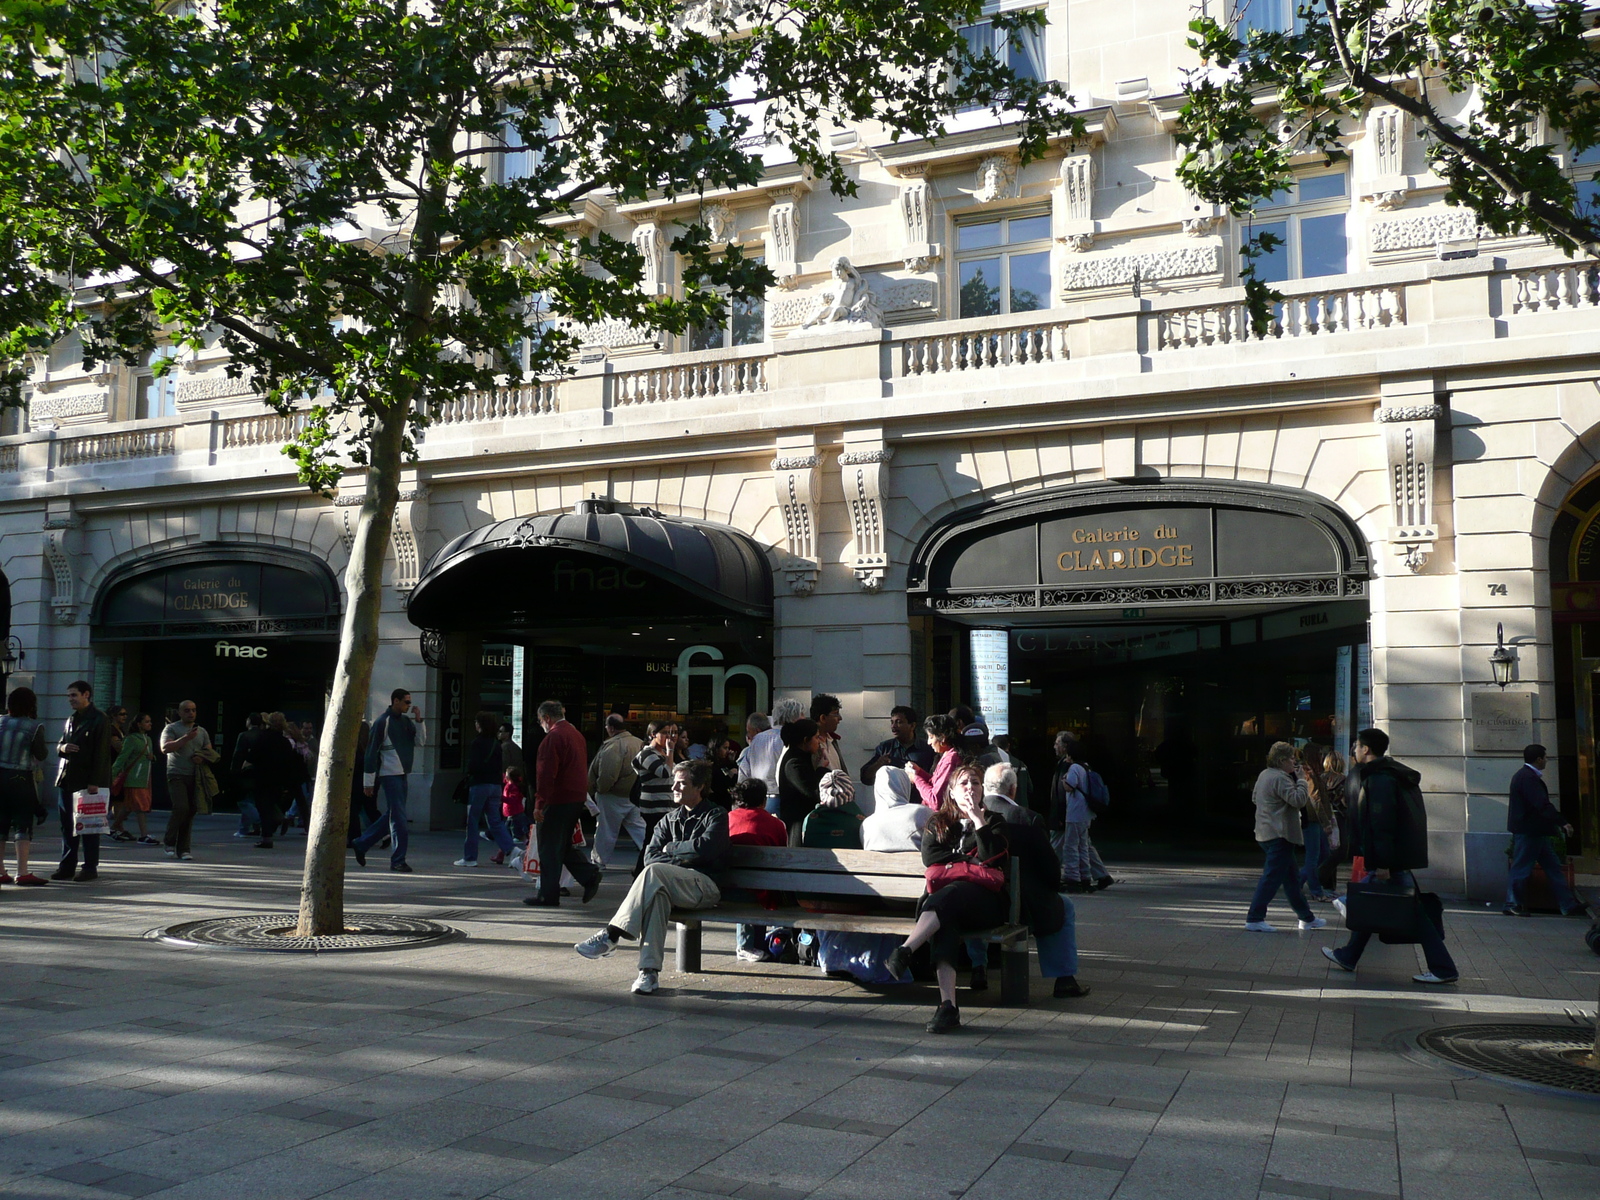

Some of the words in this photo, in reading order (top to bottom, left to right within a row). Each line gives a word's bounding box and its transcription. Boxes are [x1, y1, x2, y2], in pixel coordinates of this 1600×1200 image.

[1071, 526, 1140, 544] Galerie
[1154, 524, 1178, 540] du
[1056, 545, 1194, 571] CLARIDGE
[183, 578, 220, 590] Galerie
[228, 577, 241, 588] du
[552, 559, 648, 592] fnac
[1487, 583, 1508, 596] 74
[174, 592, 248, 610] CLARIDGE
[1299, 612, 1328, 627] FURLA
[214, 640, 268, 659] fnac
[645, 661, 675, 673] BURE
[445, 678, 461, 747] fnac
